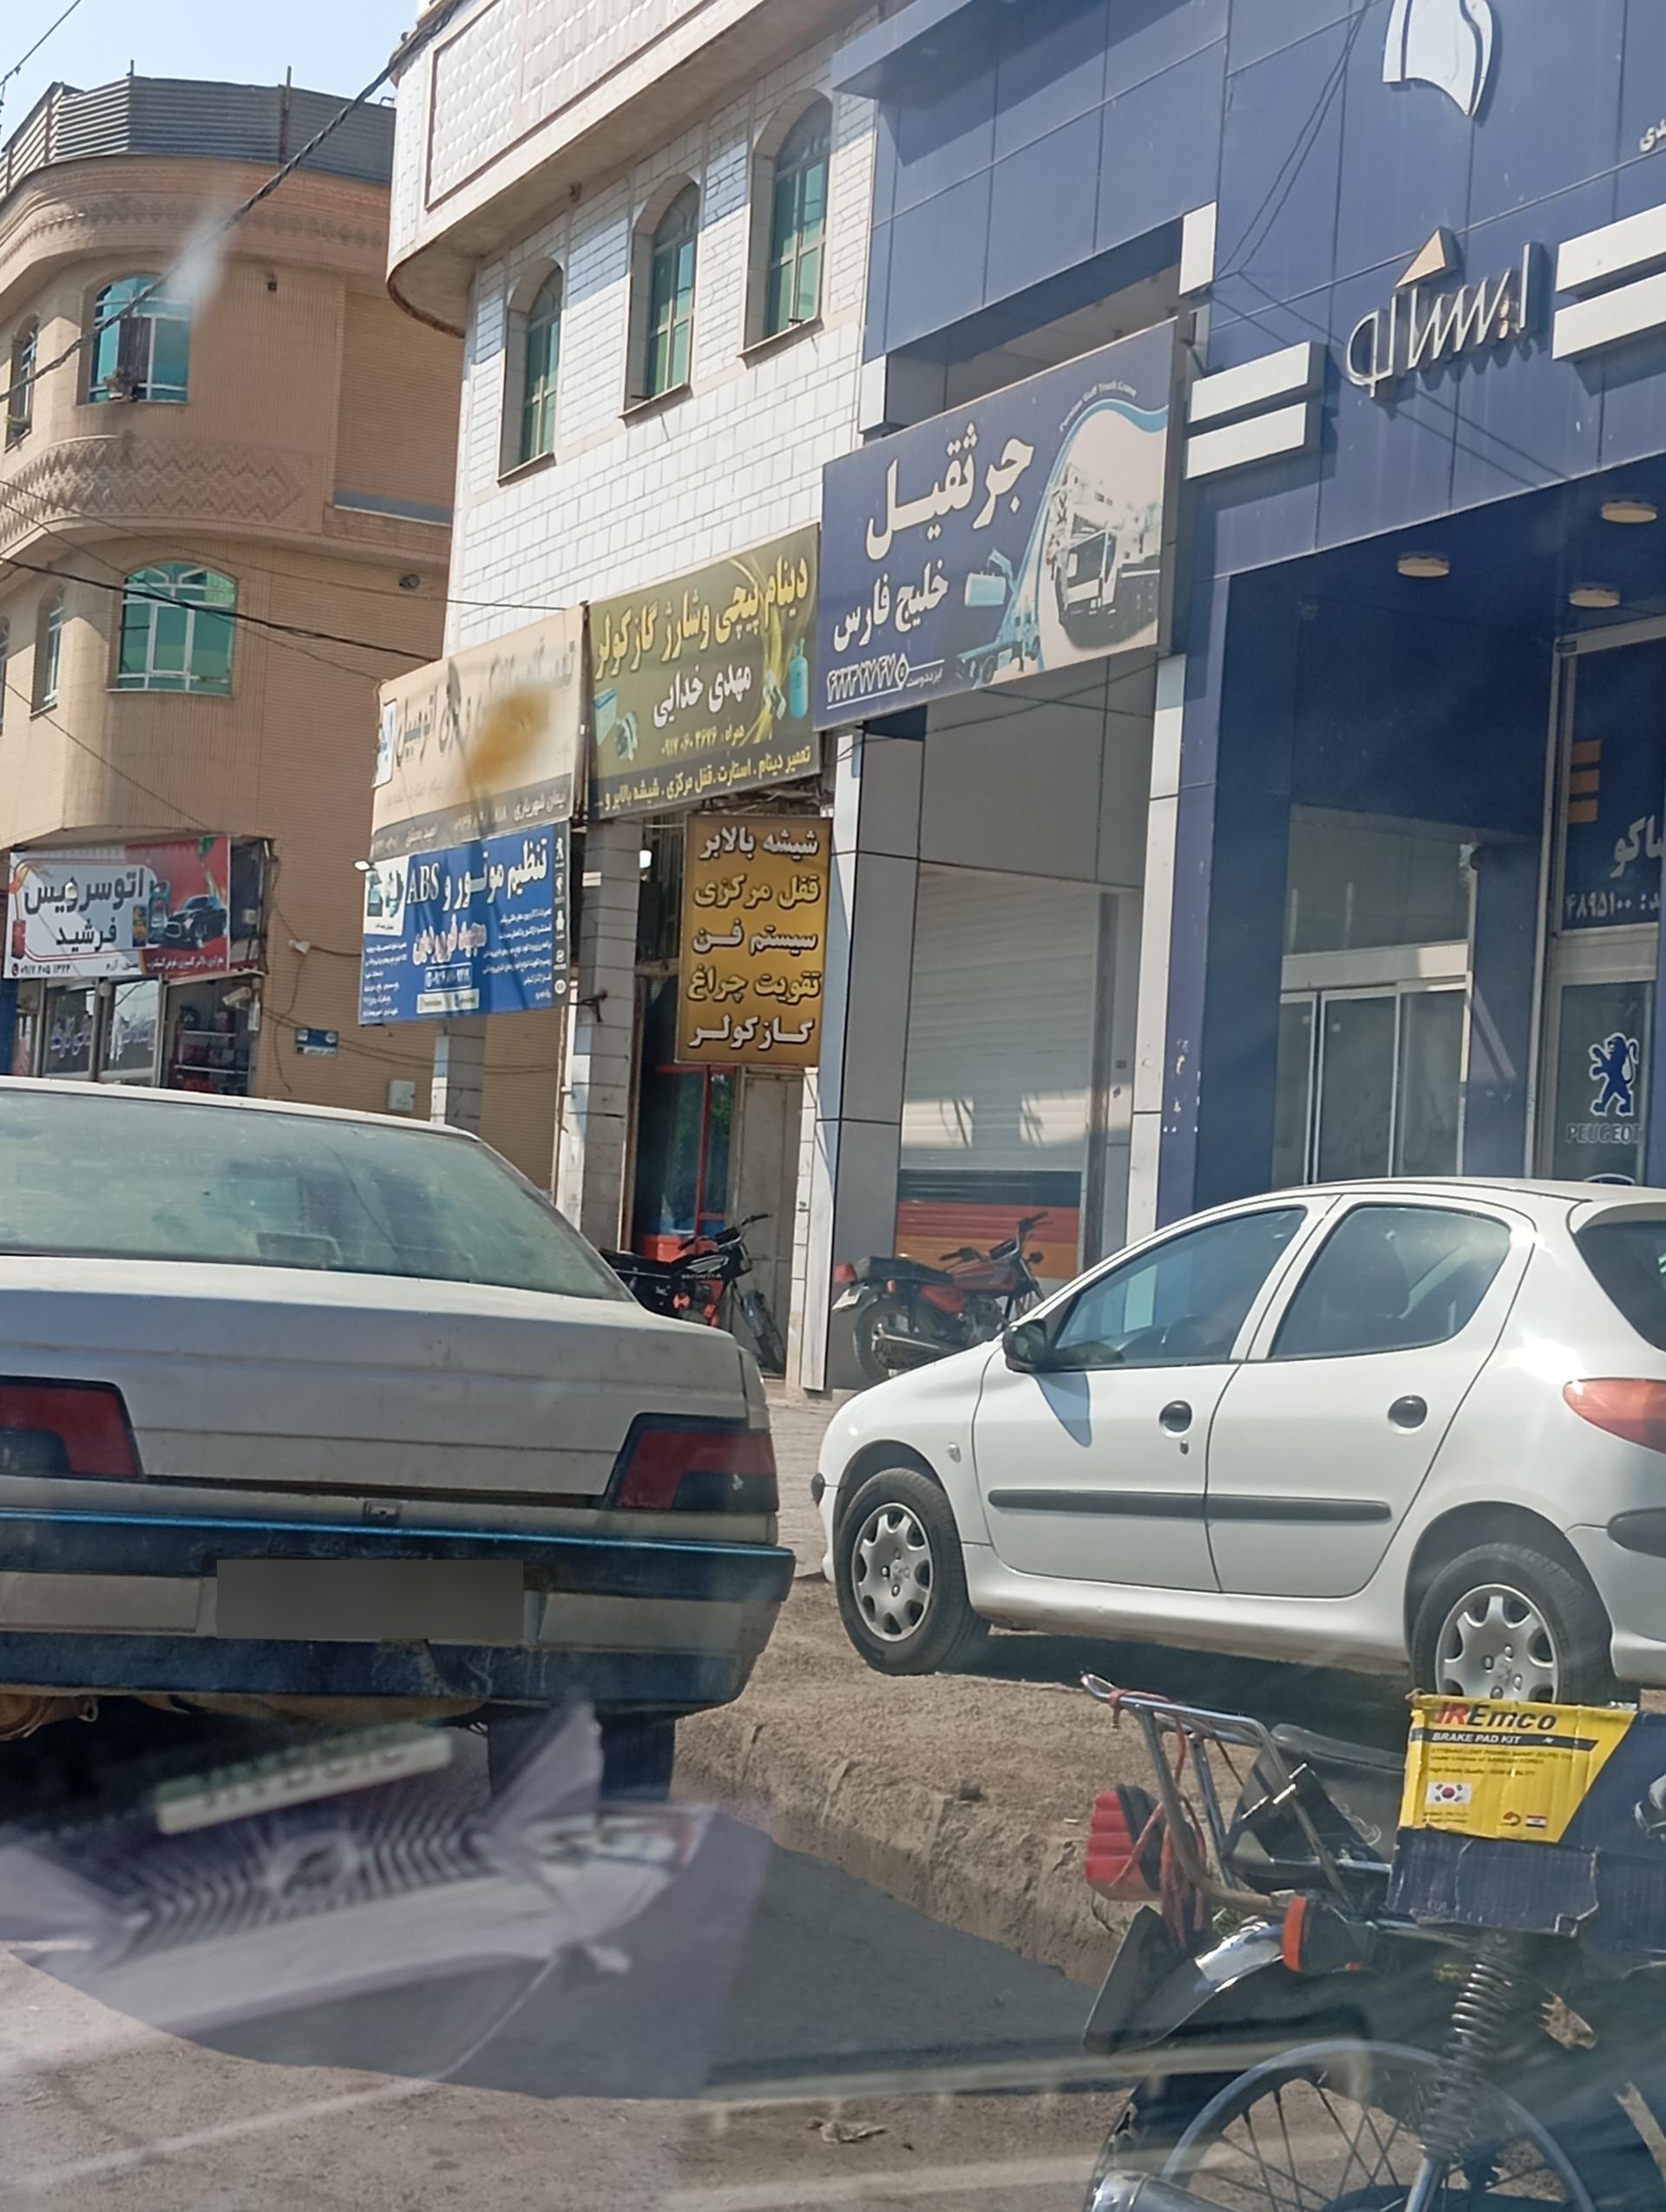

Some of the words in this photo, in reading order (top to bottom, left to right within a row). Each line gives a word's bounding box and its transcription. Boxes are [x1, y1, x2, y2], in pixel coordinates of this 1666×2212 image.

[895, 560, 949, 632] خلیج
[833, 578, 890, 651] فارس
[653, 664, 704, 728] خدایی
[708, 663, 752, 713] مهدی
[699, 826, 755, 861] بالابر
[763, 829, 819, 861] شیشه
[406, 862, 440, 905] ABS
[507, 837, 549, 900] تنظیم
[694, 874, 772, 908] مرکزی
[778, 874, 821, 909] قفل
[56, 917, 117, 952] فرشید
[692, 919, 744, 952] فن
[750, 924, 817, 955] سیستم
[687, 964, 748, 1004] چراغ
[755, 970, 822, 1005] تقویت
[1566, 1122, 1642, 1143] PEUGEOT
[1433, 1732, 1473, 1742] BRAKE
[1475, 1734, 1499, 1743] PAD
[1500, 1735, 1521, 1744] KIT
